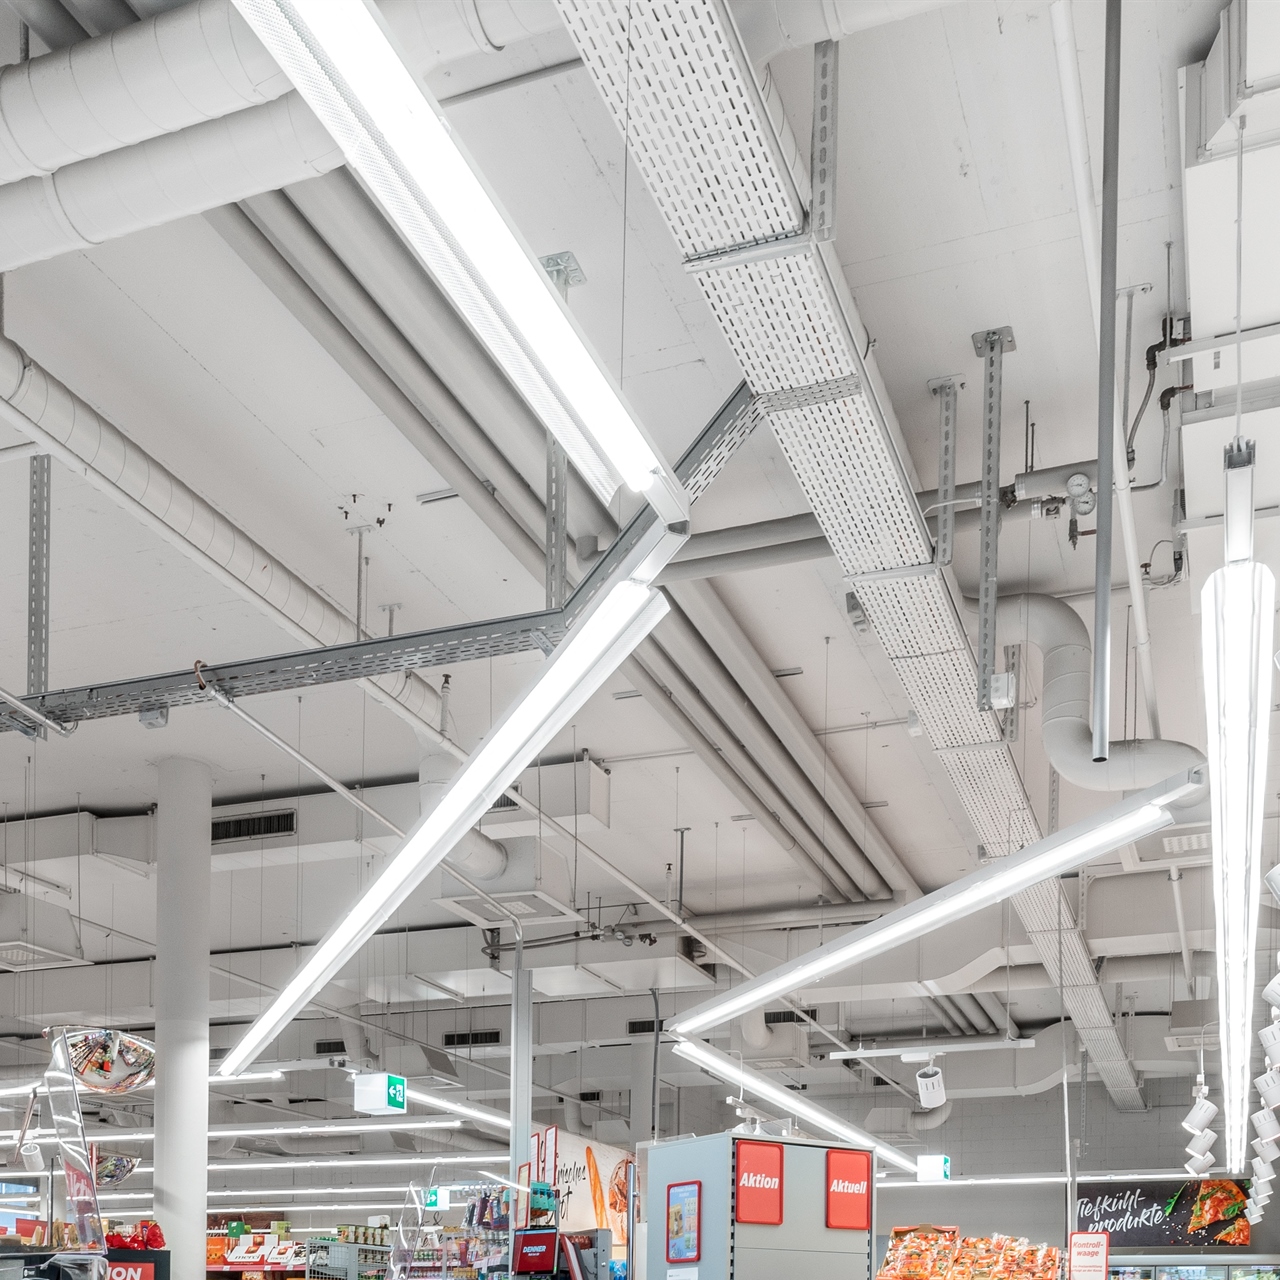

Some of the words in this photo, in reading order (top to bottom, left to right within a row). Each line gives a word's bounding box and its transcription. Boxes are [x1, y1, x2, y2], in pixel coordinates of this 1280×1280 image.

[739, 1172, 779, 1189] Aktion
[830, 1180, 867, 1194] Aktuell
[1077, 1189, 1146, 1221] Tiefkühl-
[1088, 1203, 1165, 1232] produkte
[1073, 1241, 1104, 1249] Kontroll-
[1077, 1250, 1100, 1258] waage
